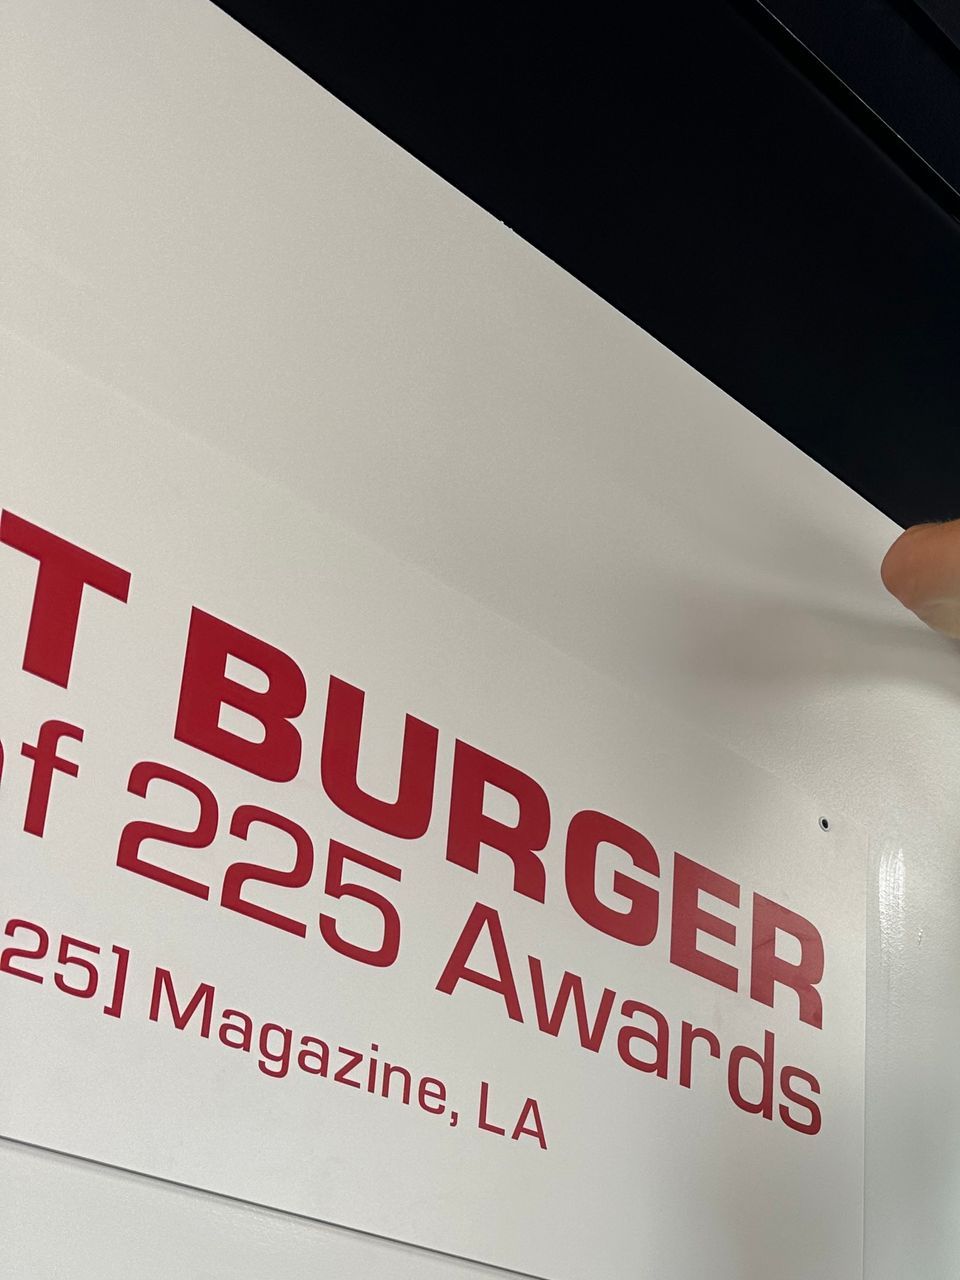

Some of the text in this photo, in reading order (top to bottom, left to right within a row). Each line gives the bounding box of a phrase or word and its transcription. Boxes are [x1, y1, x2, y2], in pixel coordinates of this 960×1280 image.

[0, 720, 820, 1134] f 225 Awards
[174, 608, 823, 1028] BURGER
[150, 967, 457, 1125] Magazine,
[479, 1084, 546, 1148] LA
